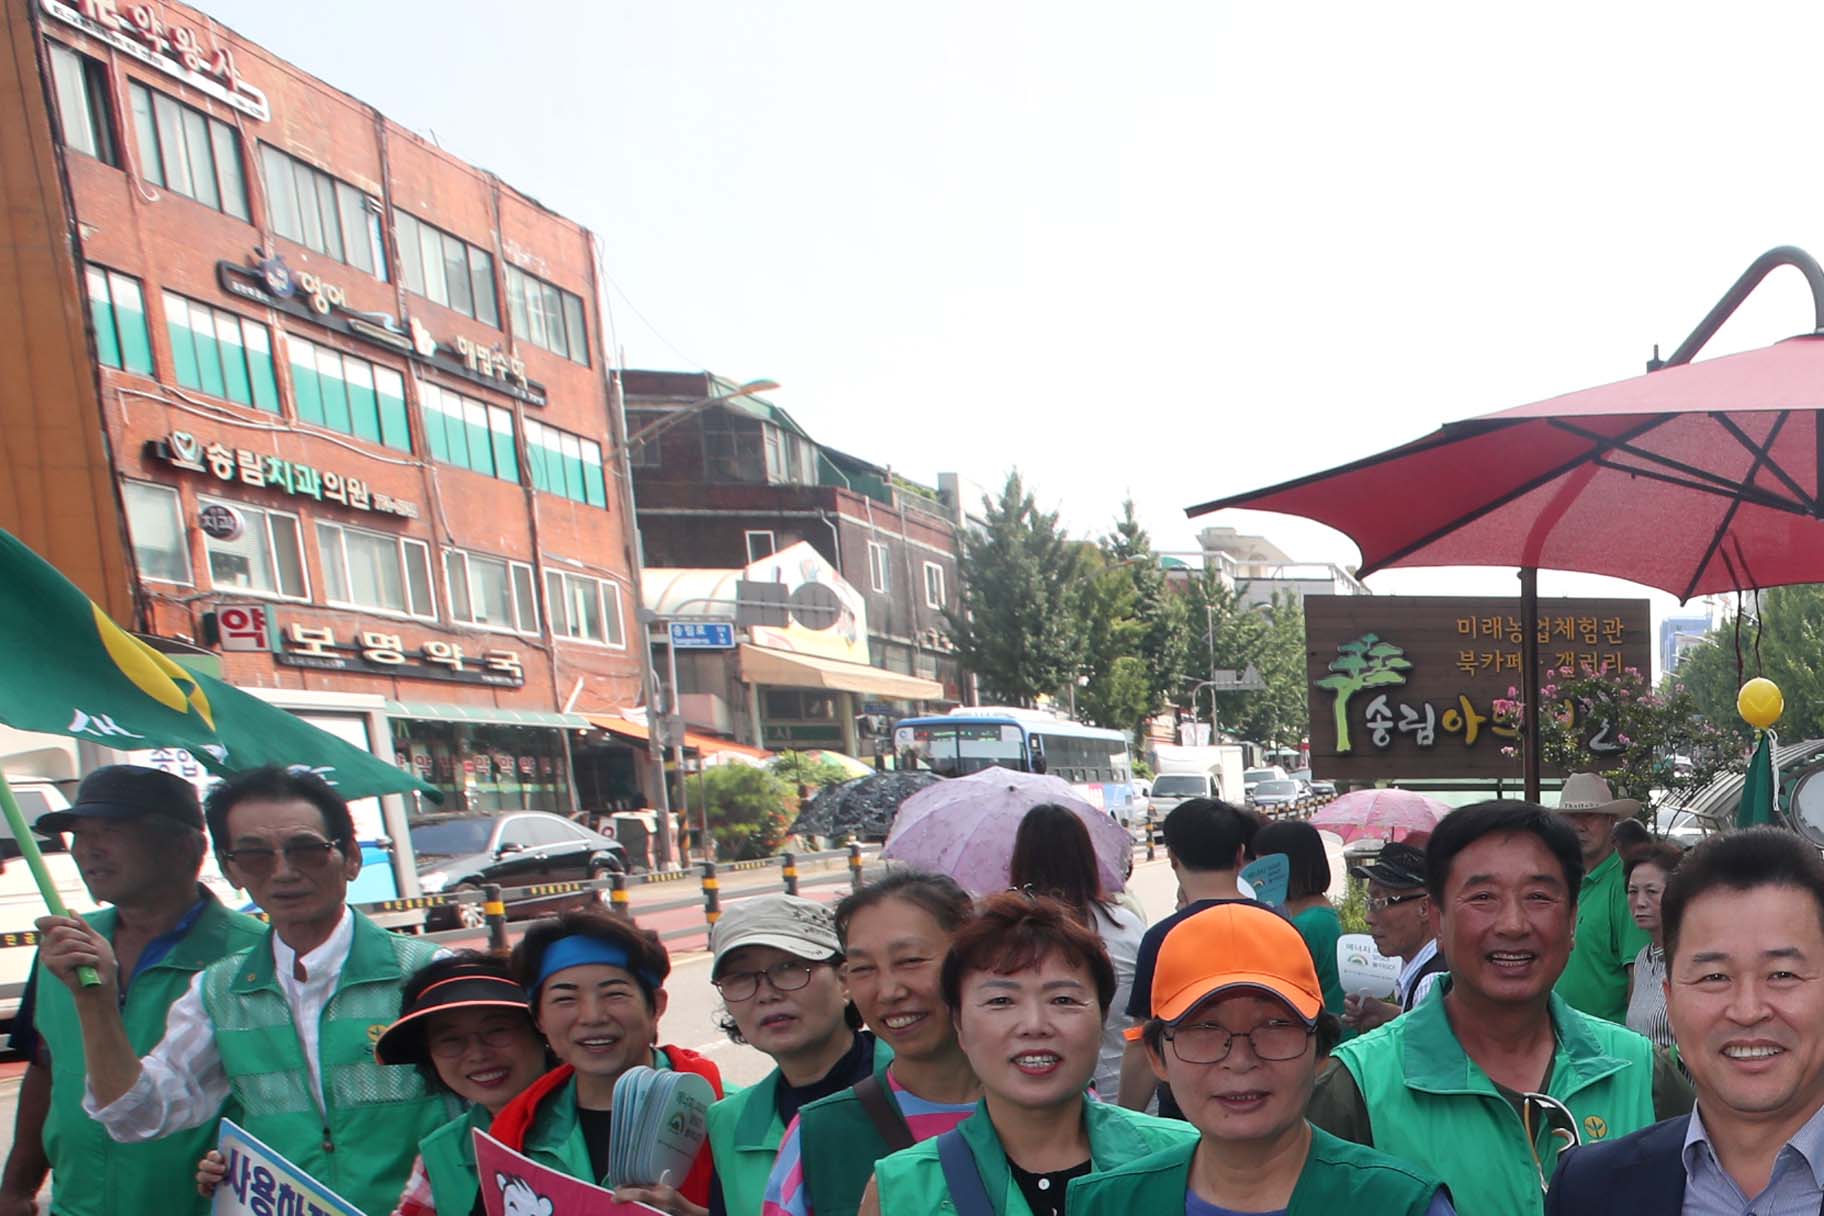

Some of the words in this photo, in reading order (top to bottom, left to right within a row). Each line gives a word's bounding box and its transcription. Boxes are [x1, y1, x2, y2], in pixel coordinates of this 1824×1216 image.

[206, 442, 372, 511] 송림치과의원
[220, 608, 266, 648] 약
[1455, 615, 1625, 645] 미래농업체험관
[289, 622, 523, 678] 보명약국
[1455, 650, 1523, 677] 북카페
